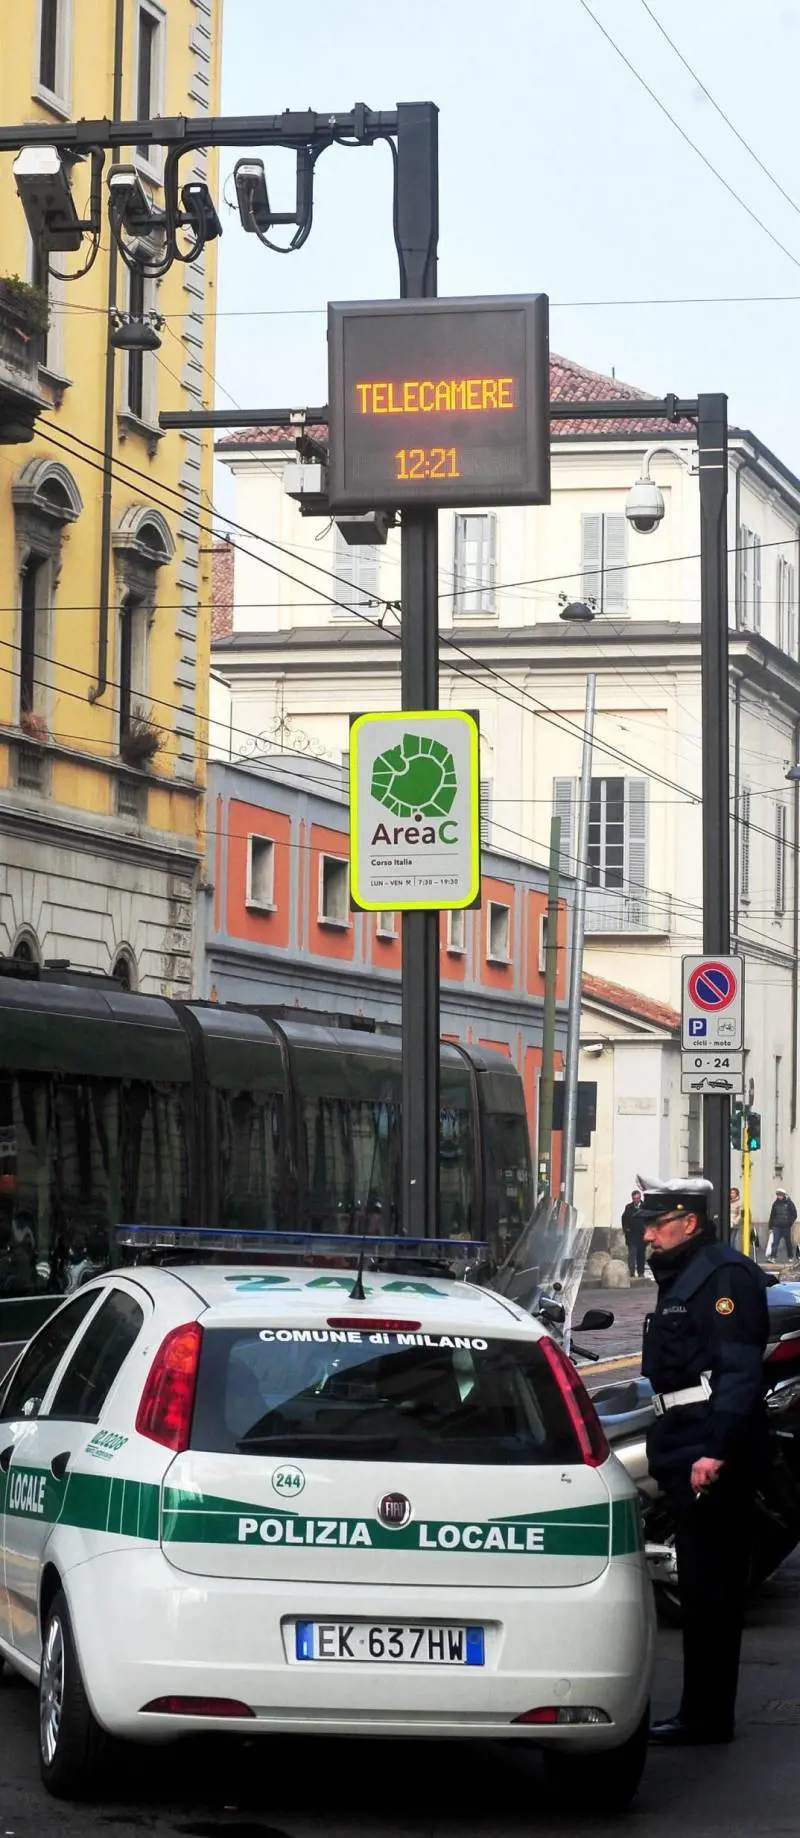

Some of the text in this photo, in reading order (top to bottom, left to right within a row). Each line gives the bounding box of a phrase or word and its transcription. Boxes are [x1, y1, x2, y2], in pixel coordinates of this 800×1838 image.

[356, 379, 513, 414] TELECAMERE
[396, 448, 460, 479] 12:21
[394, 858, 412, 866] Italia
[692, 1021, 703, 1034] P
[694, 1058, 703, 1068] 0
[714, 1058, 730, 1068] 24
[259, 1329, 488, 1351] COMUNE di MILANO
[276, 1473, 300, 1488] 244
[9, 1472, 47, 1514] LOCALE
[385, 1501, 404, 1517] FIAT
[238, 1517, 545, 1551] POLIZIA LOCALE
[318, 1625, 355, 1658] EK
[368, 1627, 463, 1661] 637HW
